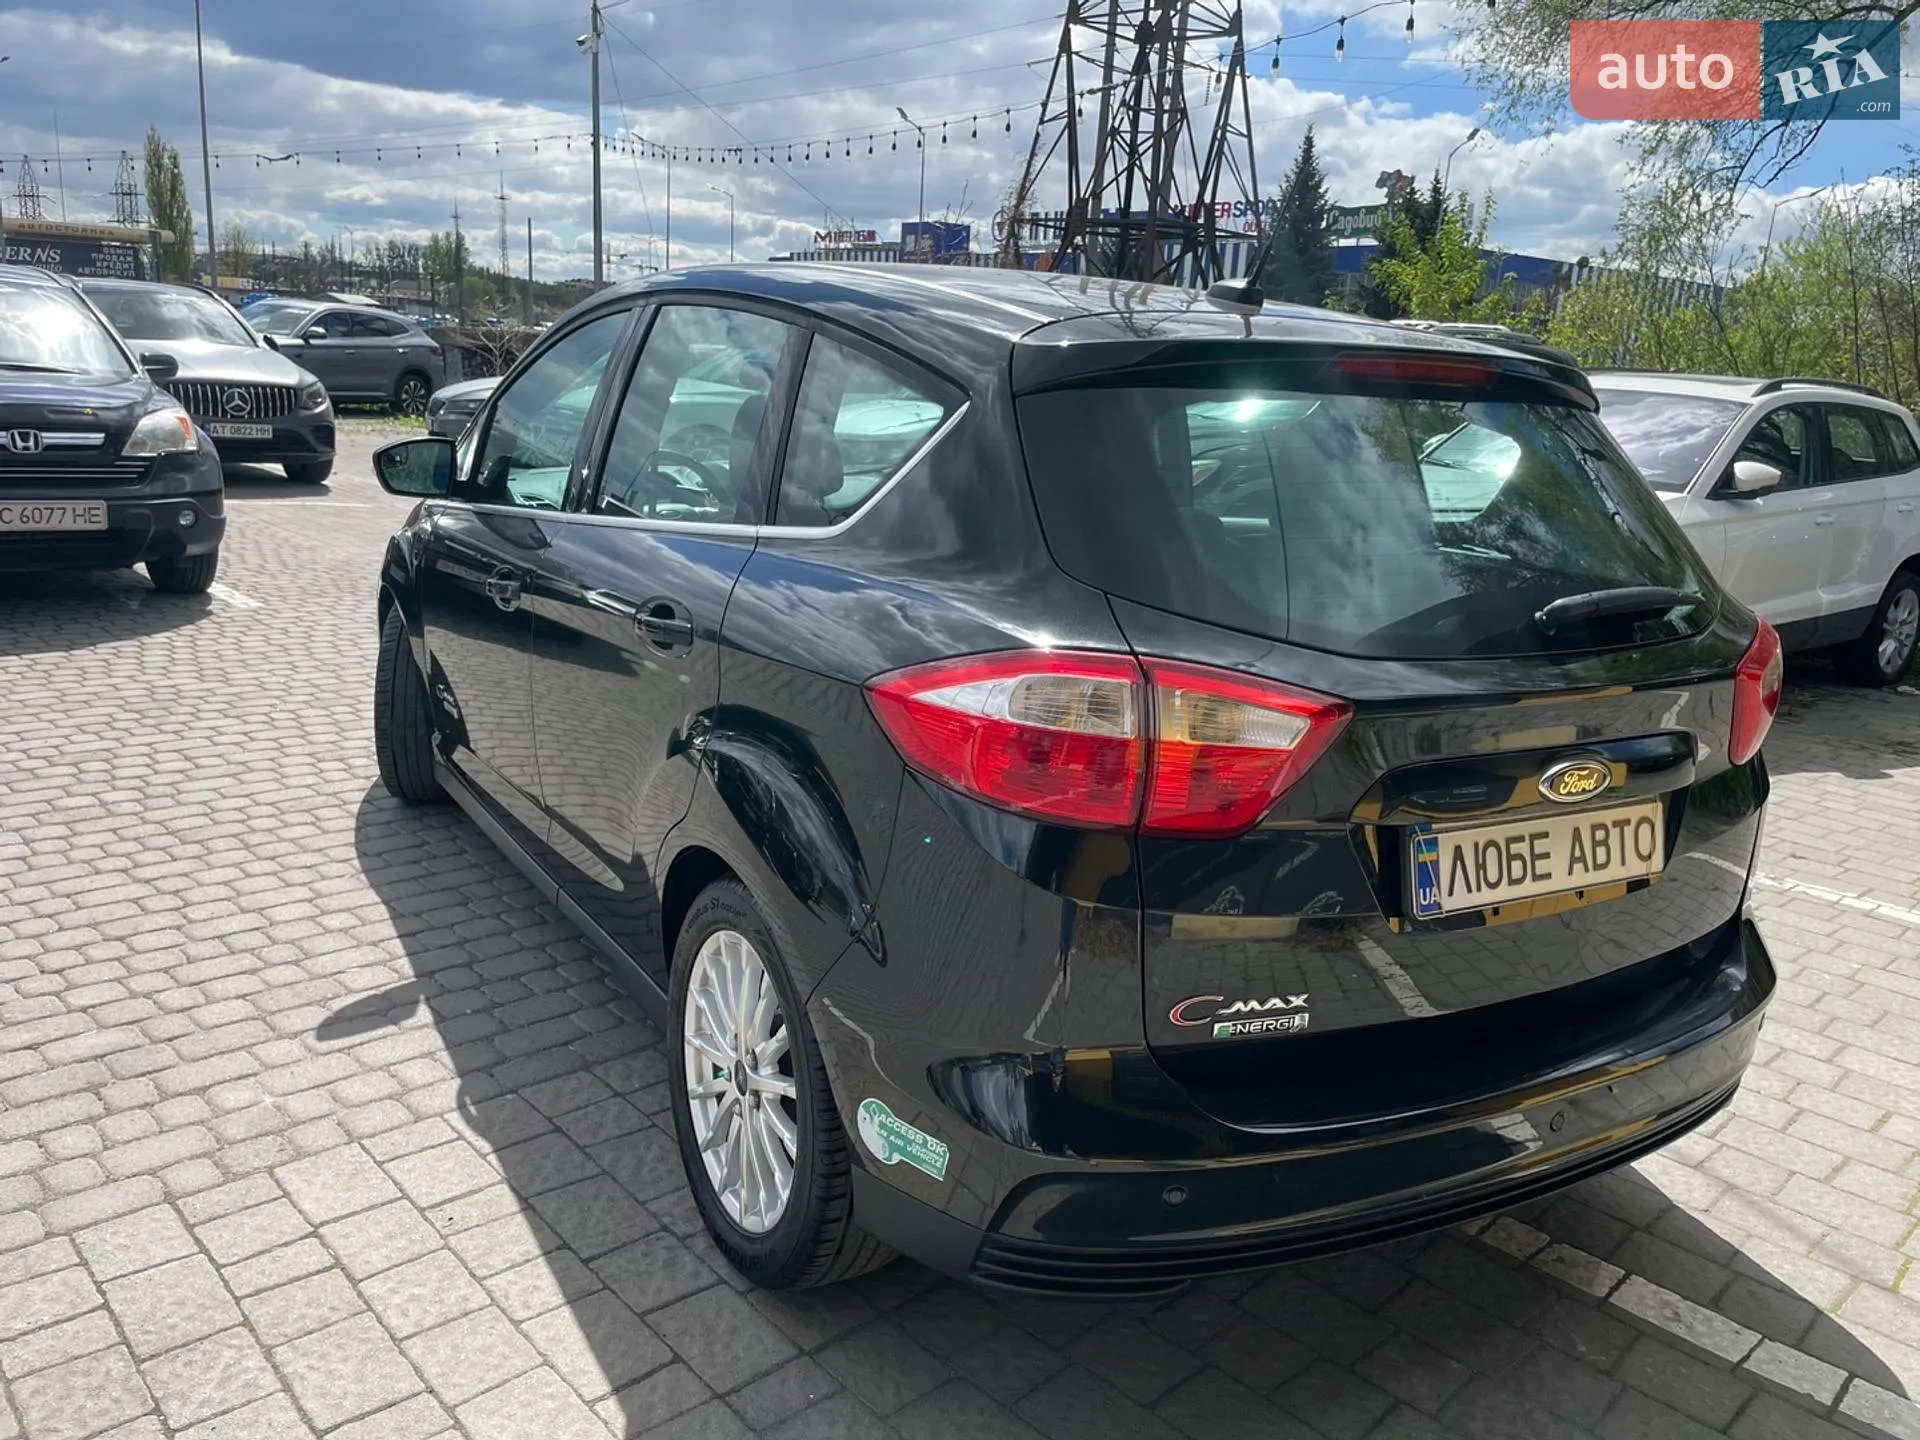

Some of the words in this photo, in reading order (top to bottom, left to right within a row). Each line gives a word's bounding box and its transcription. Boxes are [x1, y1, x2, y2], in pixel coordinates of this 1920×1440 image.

[17, 223, 115, 237] АВТОСТОЯНКА
[91, 253, 134, 262] ПРОДАЖ
[19, 506, 67, 525] 6077
[72, 507, 103, 525] HE
[1560, 769, 1597, 795] Ford
[1448, 831, 1553, 898] ЛЮБЕ
[1567, 815, 1657, 877] АВТО
[1419, 887, 1440, 905] UA
[879, 1113, 924, 1144] ACCESS
